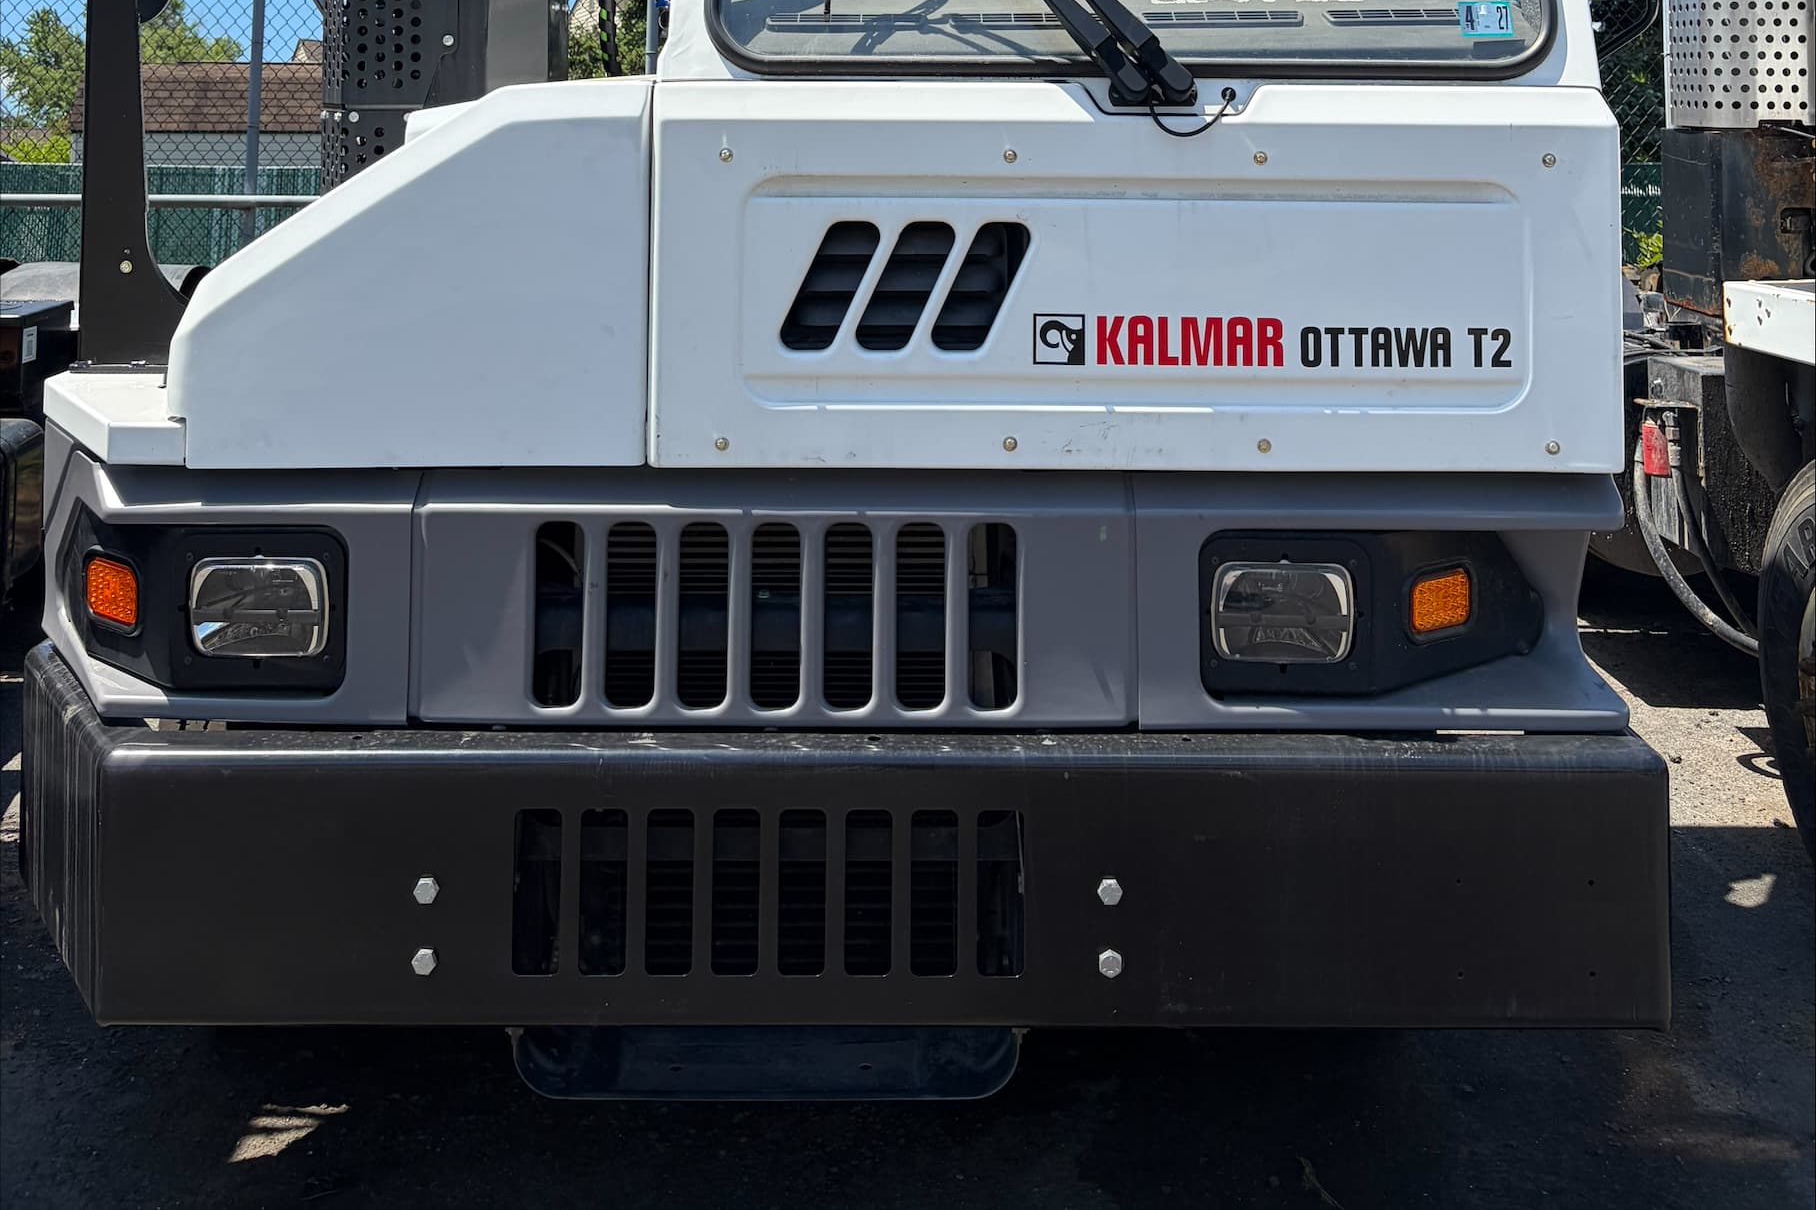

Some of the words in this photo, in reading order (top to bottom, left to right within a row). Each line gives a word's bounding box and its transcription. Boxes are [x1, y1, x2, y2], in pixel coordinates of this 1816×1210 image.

[1465, 5, 1475, 30] 4
[1496, 5, 1509, 30] 27
[1097, 315, 1284, 367] KALMAR
[1300, 327, 1452, 368] OTTAWA
[1467, 327, 1512, 368] T2
